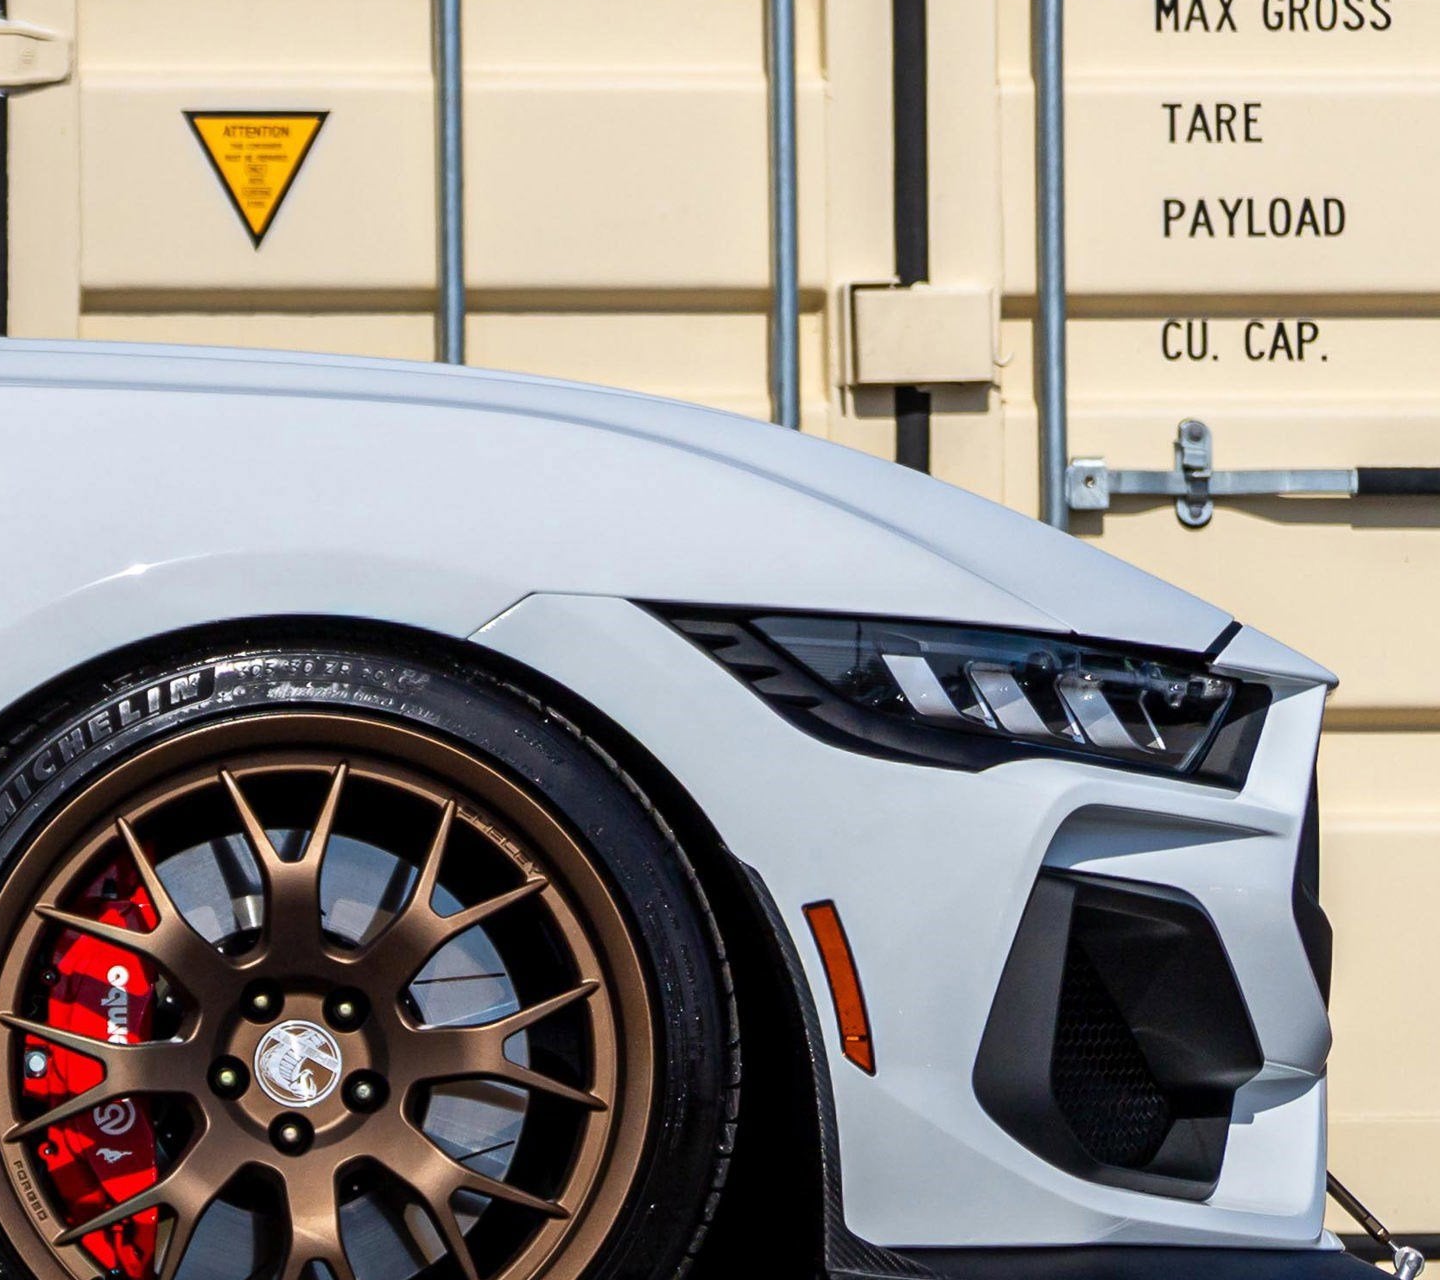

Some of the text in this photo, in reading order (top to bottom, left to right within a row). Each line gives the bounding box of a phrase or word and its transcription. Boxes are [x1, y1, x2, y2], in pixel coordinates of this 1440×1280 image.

[1162, 103, 1263, 143] TARE
[1163, 198, 1346, 238] PAYLOAD
[1161, 320, 1328, 362] CU. CAP.
[13, 1160, 48, 1222] FORGED
